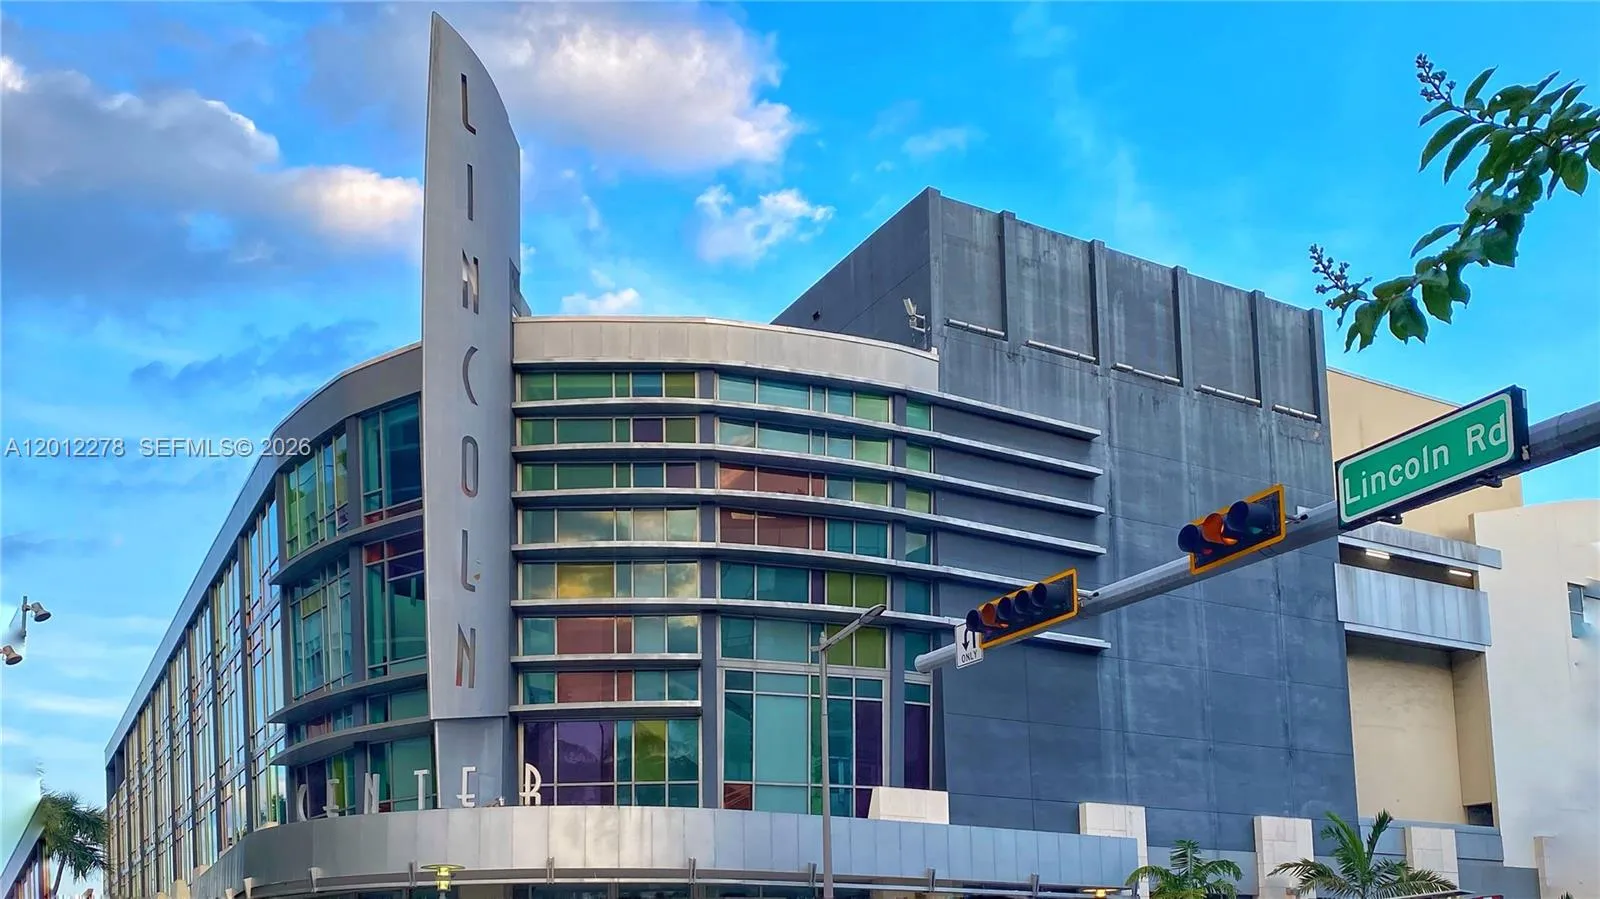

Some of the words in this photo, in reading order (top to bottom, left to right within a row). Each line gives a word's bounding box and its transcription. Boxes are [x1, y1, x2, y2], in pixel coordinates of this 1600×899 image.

[456, 73, 479, 689] LINCOLN
[1344, 445, 1449, 505] Lincoln
[1466, 413, 1506, 456] Rd
[961, 650, 978, 663] ONLY
[297, 763, 542, 822] CENTER
